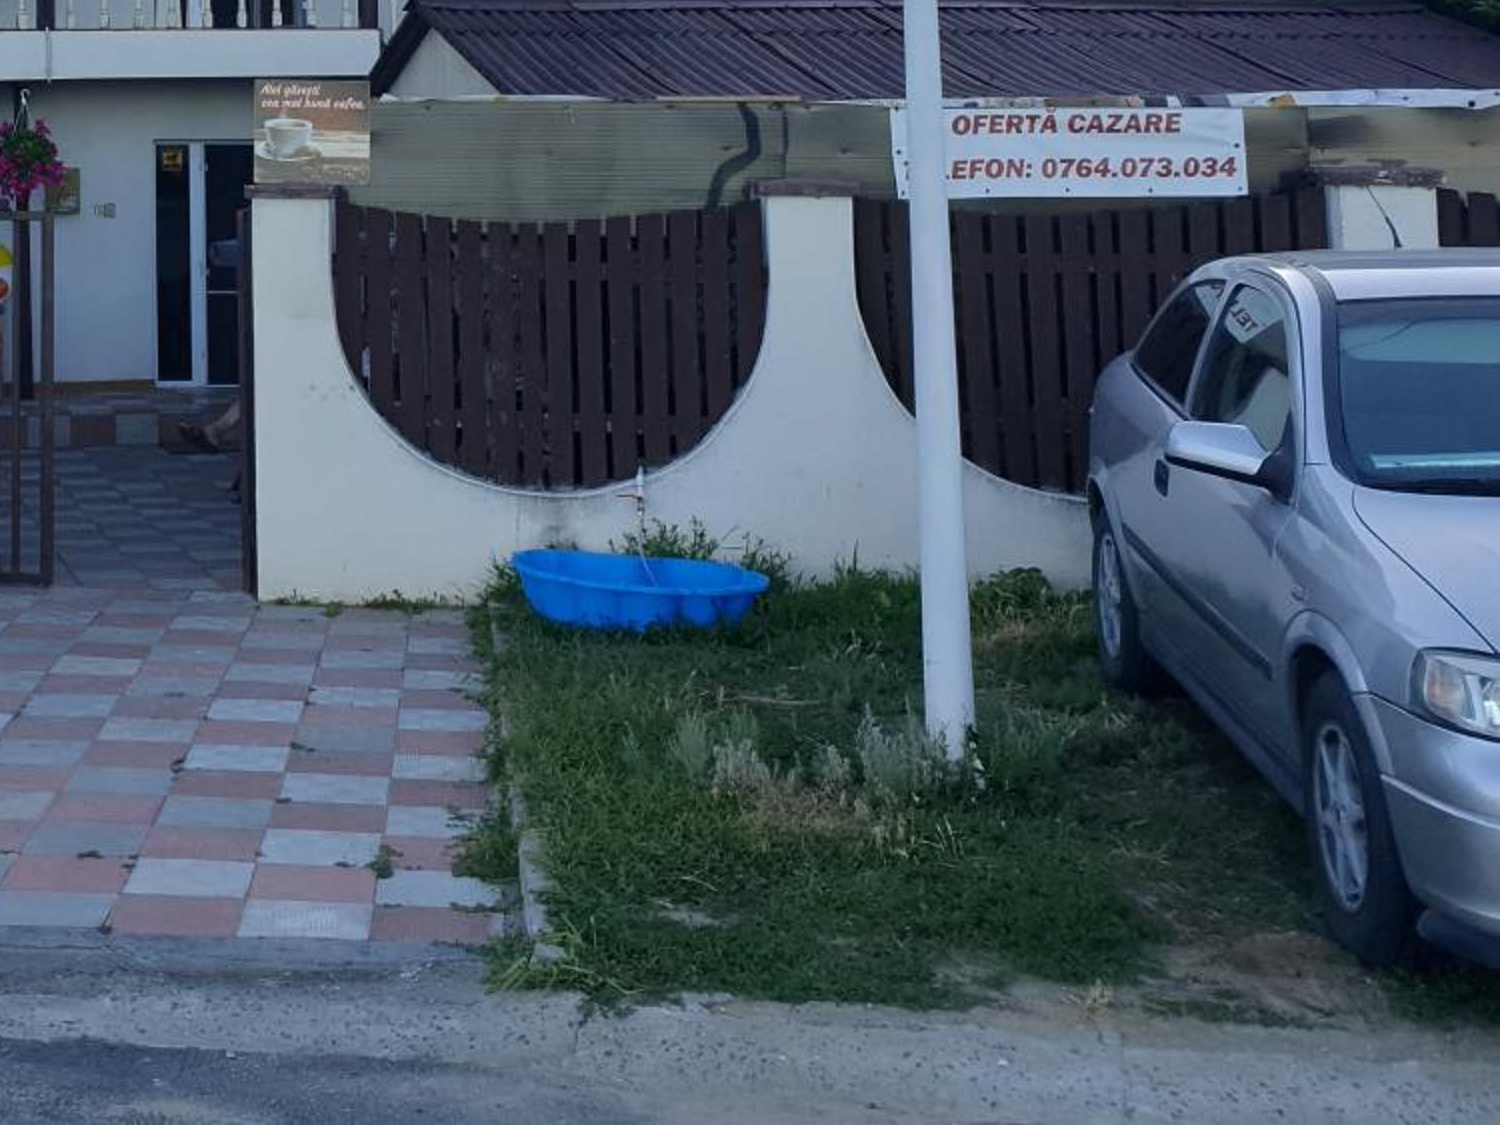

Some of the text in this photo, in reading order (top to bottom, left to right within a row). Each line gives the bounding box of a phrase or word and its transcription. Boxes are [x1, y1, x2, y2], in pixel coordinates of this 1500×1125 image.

[951, 106, 1183, 136] OFERTĂ CAZARE
[1041, 156, 1238, 179] 0764.073.034
